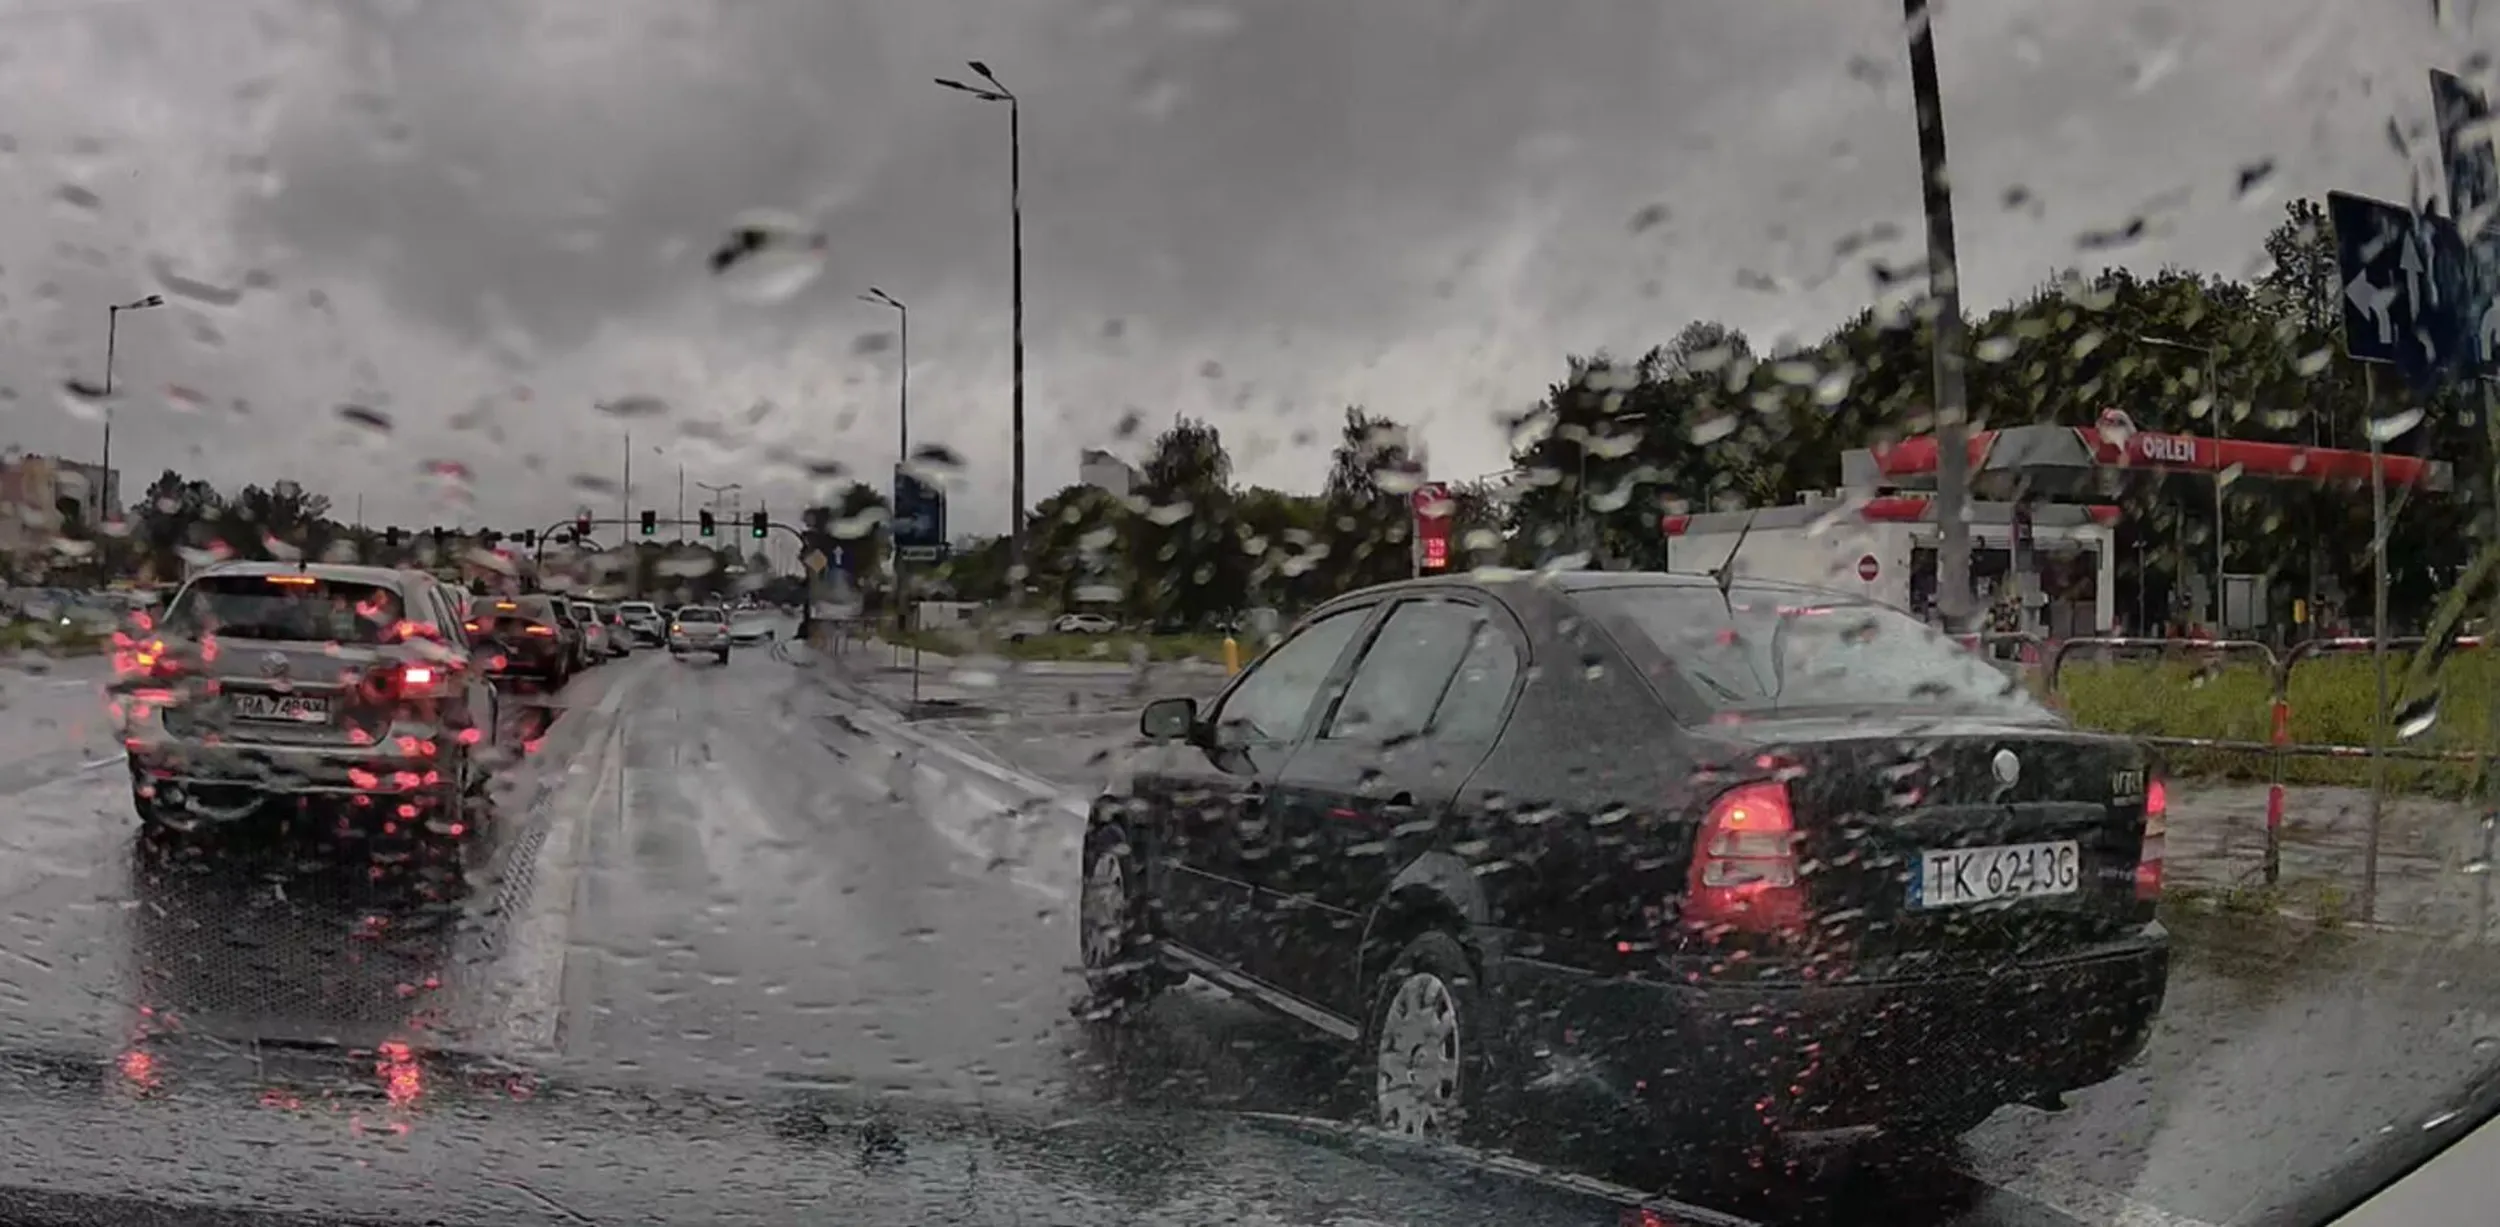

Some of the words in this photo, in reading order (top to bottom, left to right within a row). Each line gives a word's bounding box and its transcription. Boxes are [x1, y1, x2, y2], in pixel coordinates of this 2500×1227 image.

[2142, 437, 2195, 462] ORLEN
[1930, 854, 1975, 900] TK
[1986, 846, 2073, 894] 6213G
